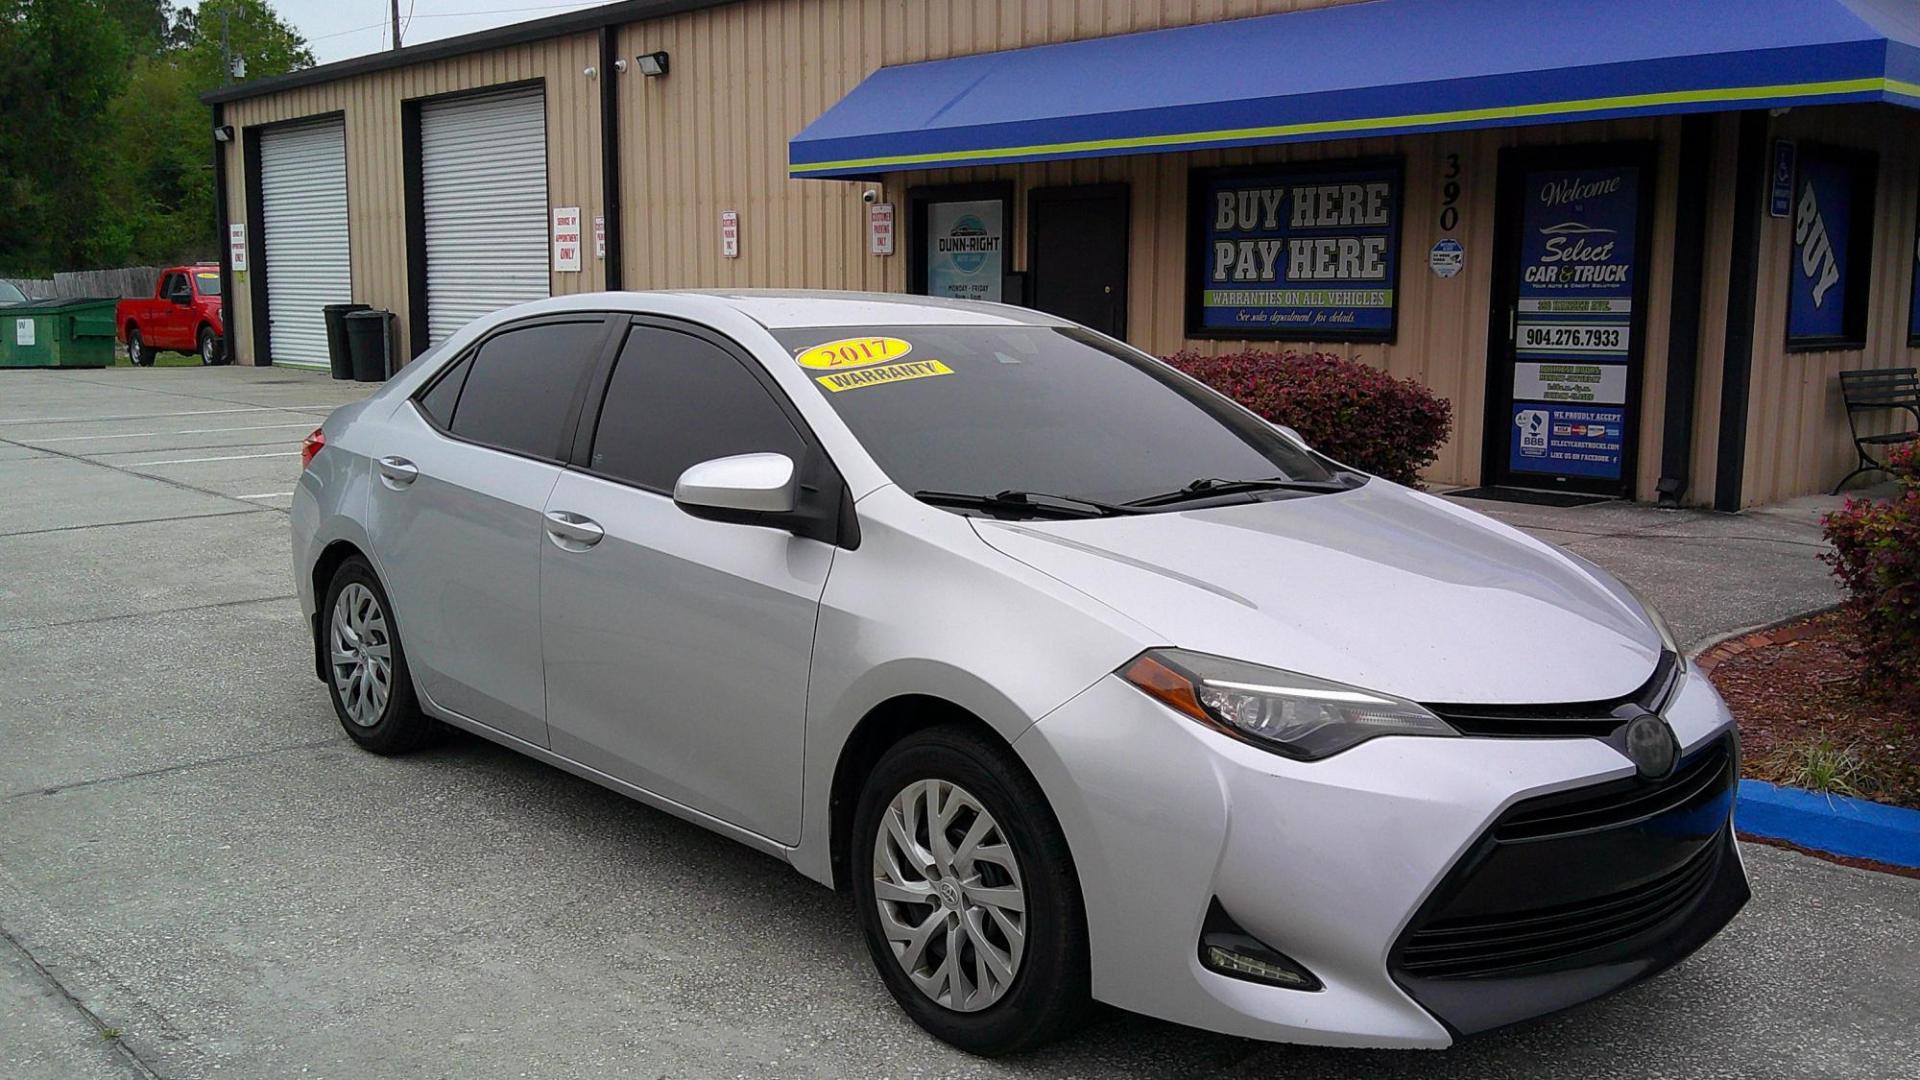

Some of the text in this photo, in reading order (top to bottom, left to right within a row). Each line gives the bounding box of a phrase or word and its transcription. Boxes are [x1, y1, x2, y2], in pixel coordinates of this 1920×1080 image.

[1440, 153, 1461, 231] 390
[1541, 176, 1621, 207] Welcome
[1215, 182, 1389, 231] BUY HERE
[939, 236, 1001, 252] DUNN-RIGHT
[1541, 236, 1615, 262] Select
[1796, 179, 1840, 309] BUY
[560, 248, 576, 260] ONLY
[1213, 237, 1386, 281] PAY HERE
[1525, 264, 1630, 283] CAR & TRUCK
[1212, 291, 1385, 306] WARRANTIES ON ALL VEHICLES
[1270, 311, 1311, 325] department
[1313, 311, 1327, 325] for
[1527, 329, 1620, 347] 904.276.7933
[821, 340, 889, 367] 2017
[830, 362, 936, 388] WARRANTY
[1553, 411, 1622, 422] WE PROUDLY ACCEPT
[1524, 437, 1544, 446] BBB
[1550, 452, 1564, 460] LIKE
[1581, 454, 1610, 463] FACEBOOK
